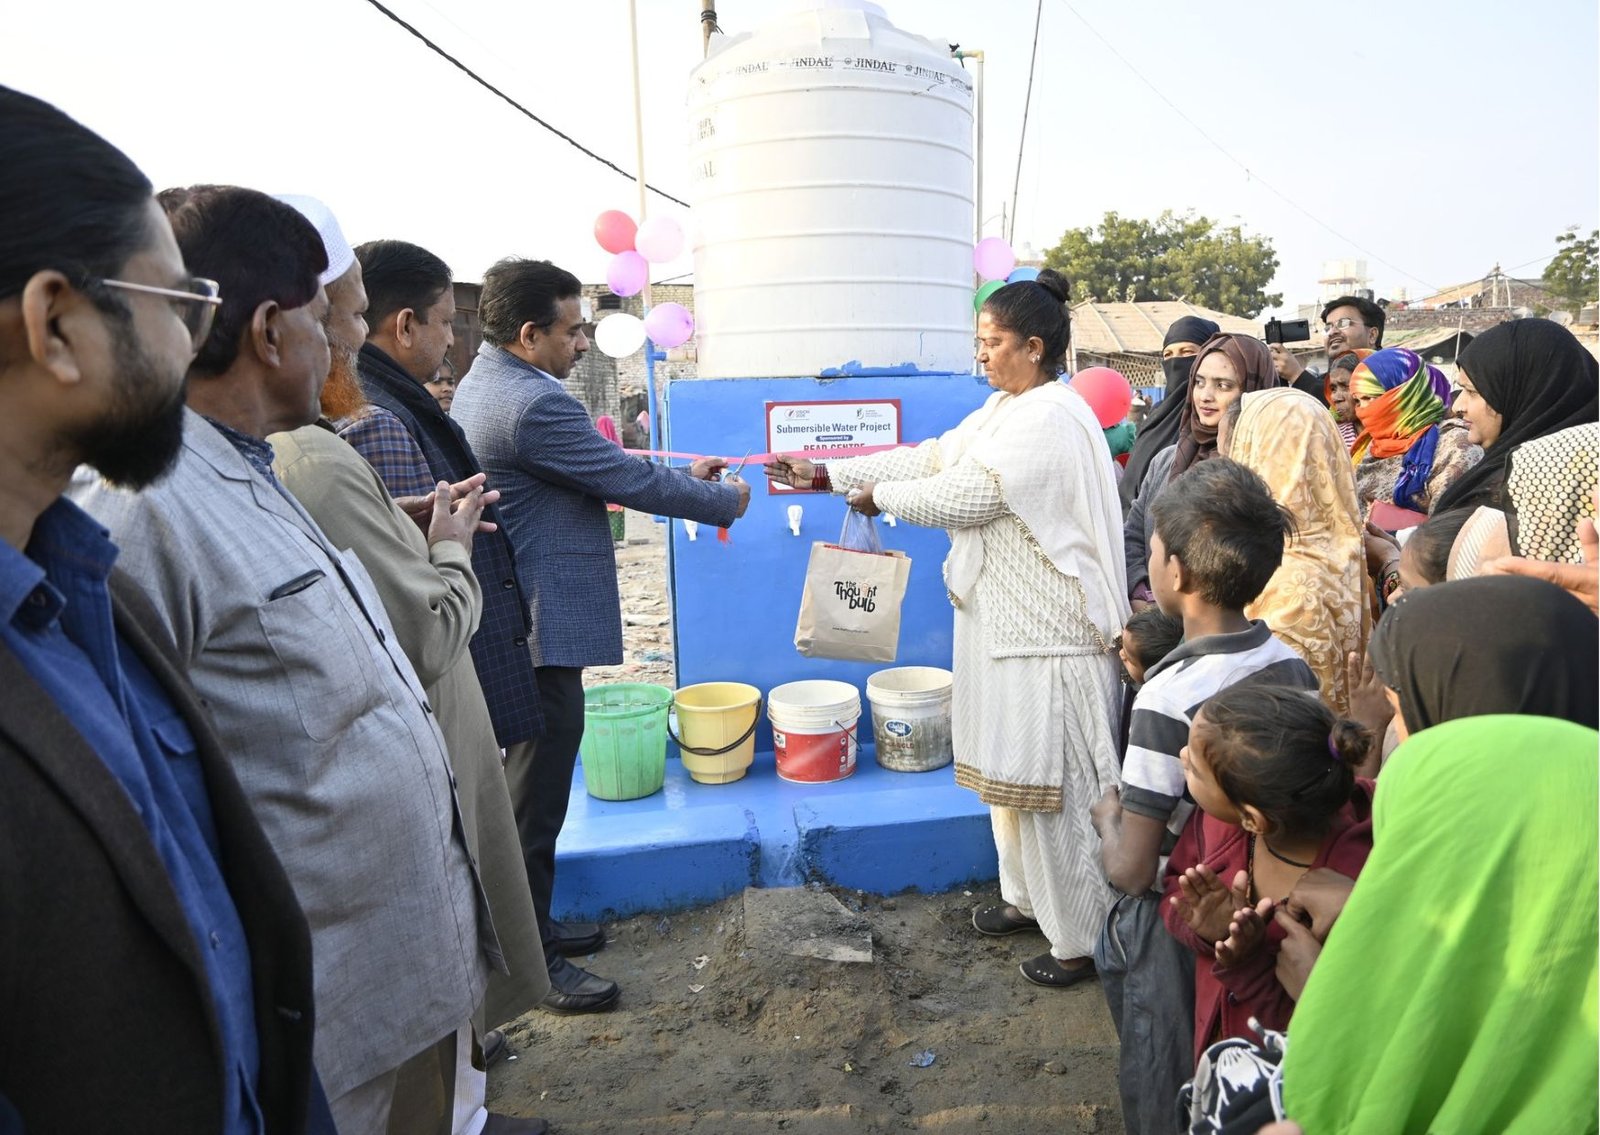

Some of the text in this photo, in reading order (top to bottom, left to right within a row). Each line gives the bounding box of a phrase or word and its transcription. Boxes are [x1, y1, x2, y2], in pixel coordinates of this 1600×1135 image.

[854, 57, 896, 72] JINDAL
[776, 421, 891, 434] Submersible Water Project
[849, 598, 876, 613] bulb
